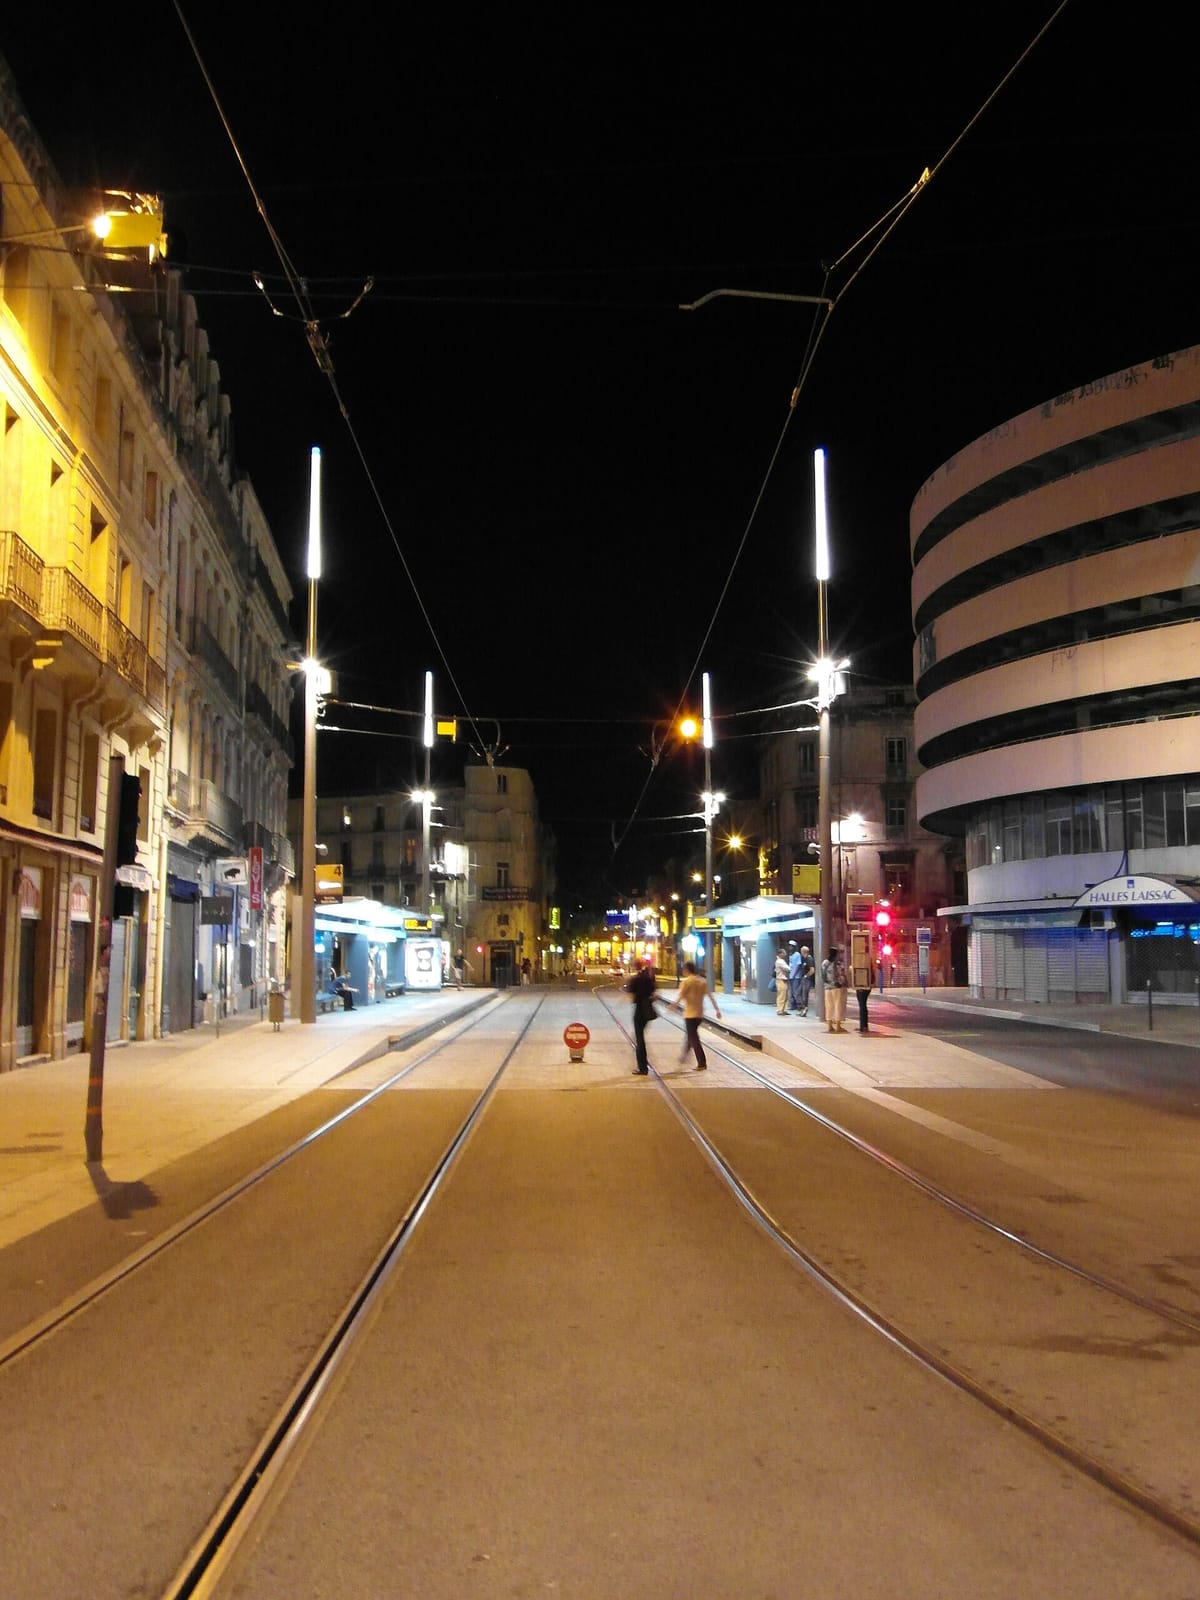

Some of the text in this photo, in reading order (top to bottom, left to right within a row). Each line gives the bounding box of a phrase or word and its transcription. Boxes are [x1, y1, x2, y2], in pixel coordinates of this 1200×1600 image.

[334, 866, 342, 876] 4
[793, 866, 801, 876] 3
[1089, 889, 1177, 902] HALLES LAISSAC
